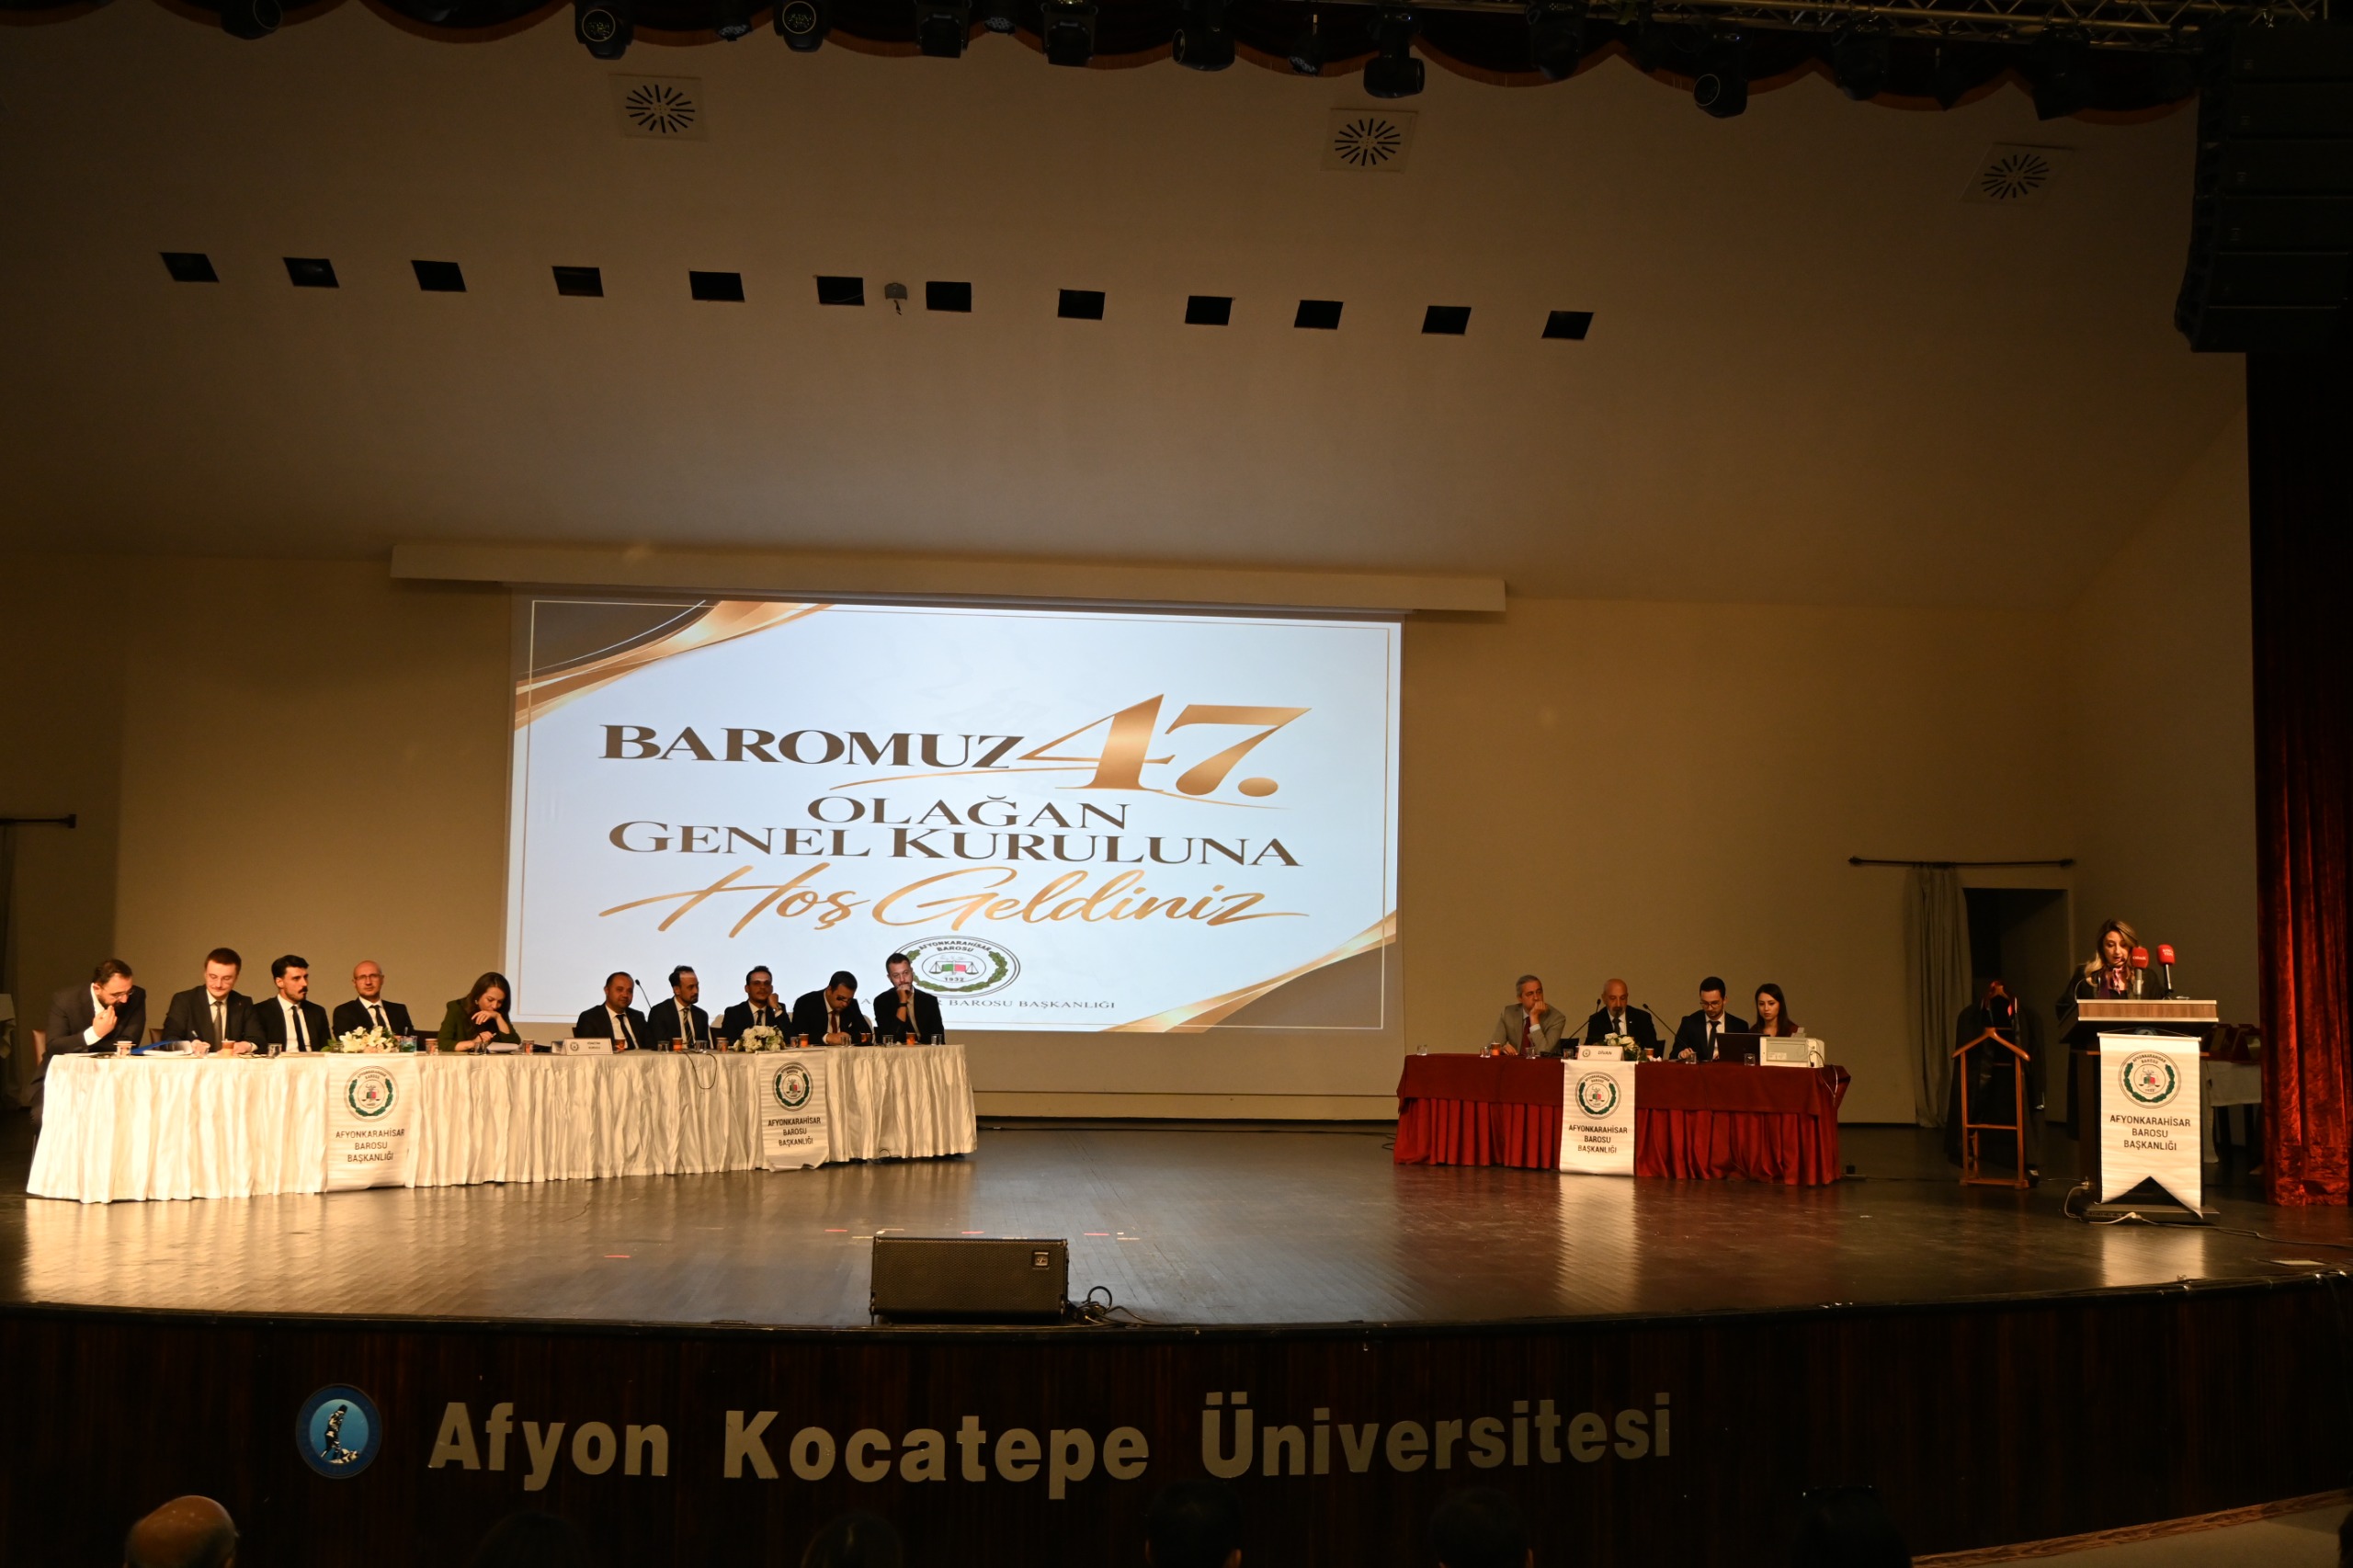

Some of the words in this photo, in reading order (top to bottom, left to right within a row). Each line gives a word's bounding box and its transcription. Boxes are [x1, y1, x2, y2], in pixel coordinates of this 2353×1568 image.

[598, 724, 1025, 768] BAROMUZ
[1016, 693, 1313, 798] 47.
[807, 794, 1131, 830] OLAĞAN
[608, 821, 871, 858] GENEL
[890, 828, 1304, 867] KURULUNA
[598, 861, 871, 938] Hoş
[871, 866, 1311, 932] Geldiniz
[949, 999, 1013, 1007] BAROSU
[1018, 1000, 1116, 1010] BAŞKANLIĞI
[767, 1115, 821, 1127] AFYONKARAHİSAR
[2109, 1114, 2191, 1128] AFYONKARAHİSAR
[335, 1127, 405, 1139] AFYONKARAHİSAR
[782, 1128, 807, 1136] BAROSU
[1568, 1124, 1628, 1134] AFYONKARAHİSAR
[2131, 1128, 2169, 1138] BAROSU
[778, 1135, 813, 1147] BAŞKANLIĞI
[1584, 1135, 1611, 1143] BAROSU
[354, 1142, 388, 1151] BAROSU
[1577, 1144, 1618, 1154] BAŞKANLIĞI
[2123, 1140, 2177, 1151] BAŞKANLIĞI
[347, 1152, 394, 1165] BAŞKANLIĞI
[427, 1402, 670, 1492] Afyon
[723, 1410, 1150, 1501] Kocatepe
[1201, 1391, 1670, 1479] Üniversitesi
